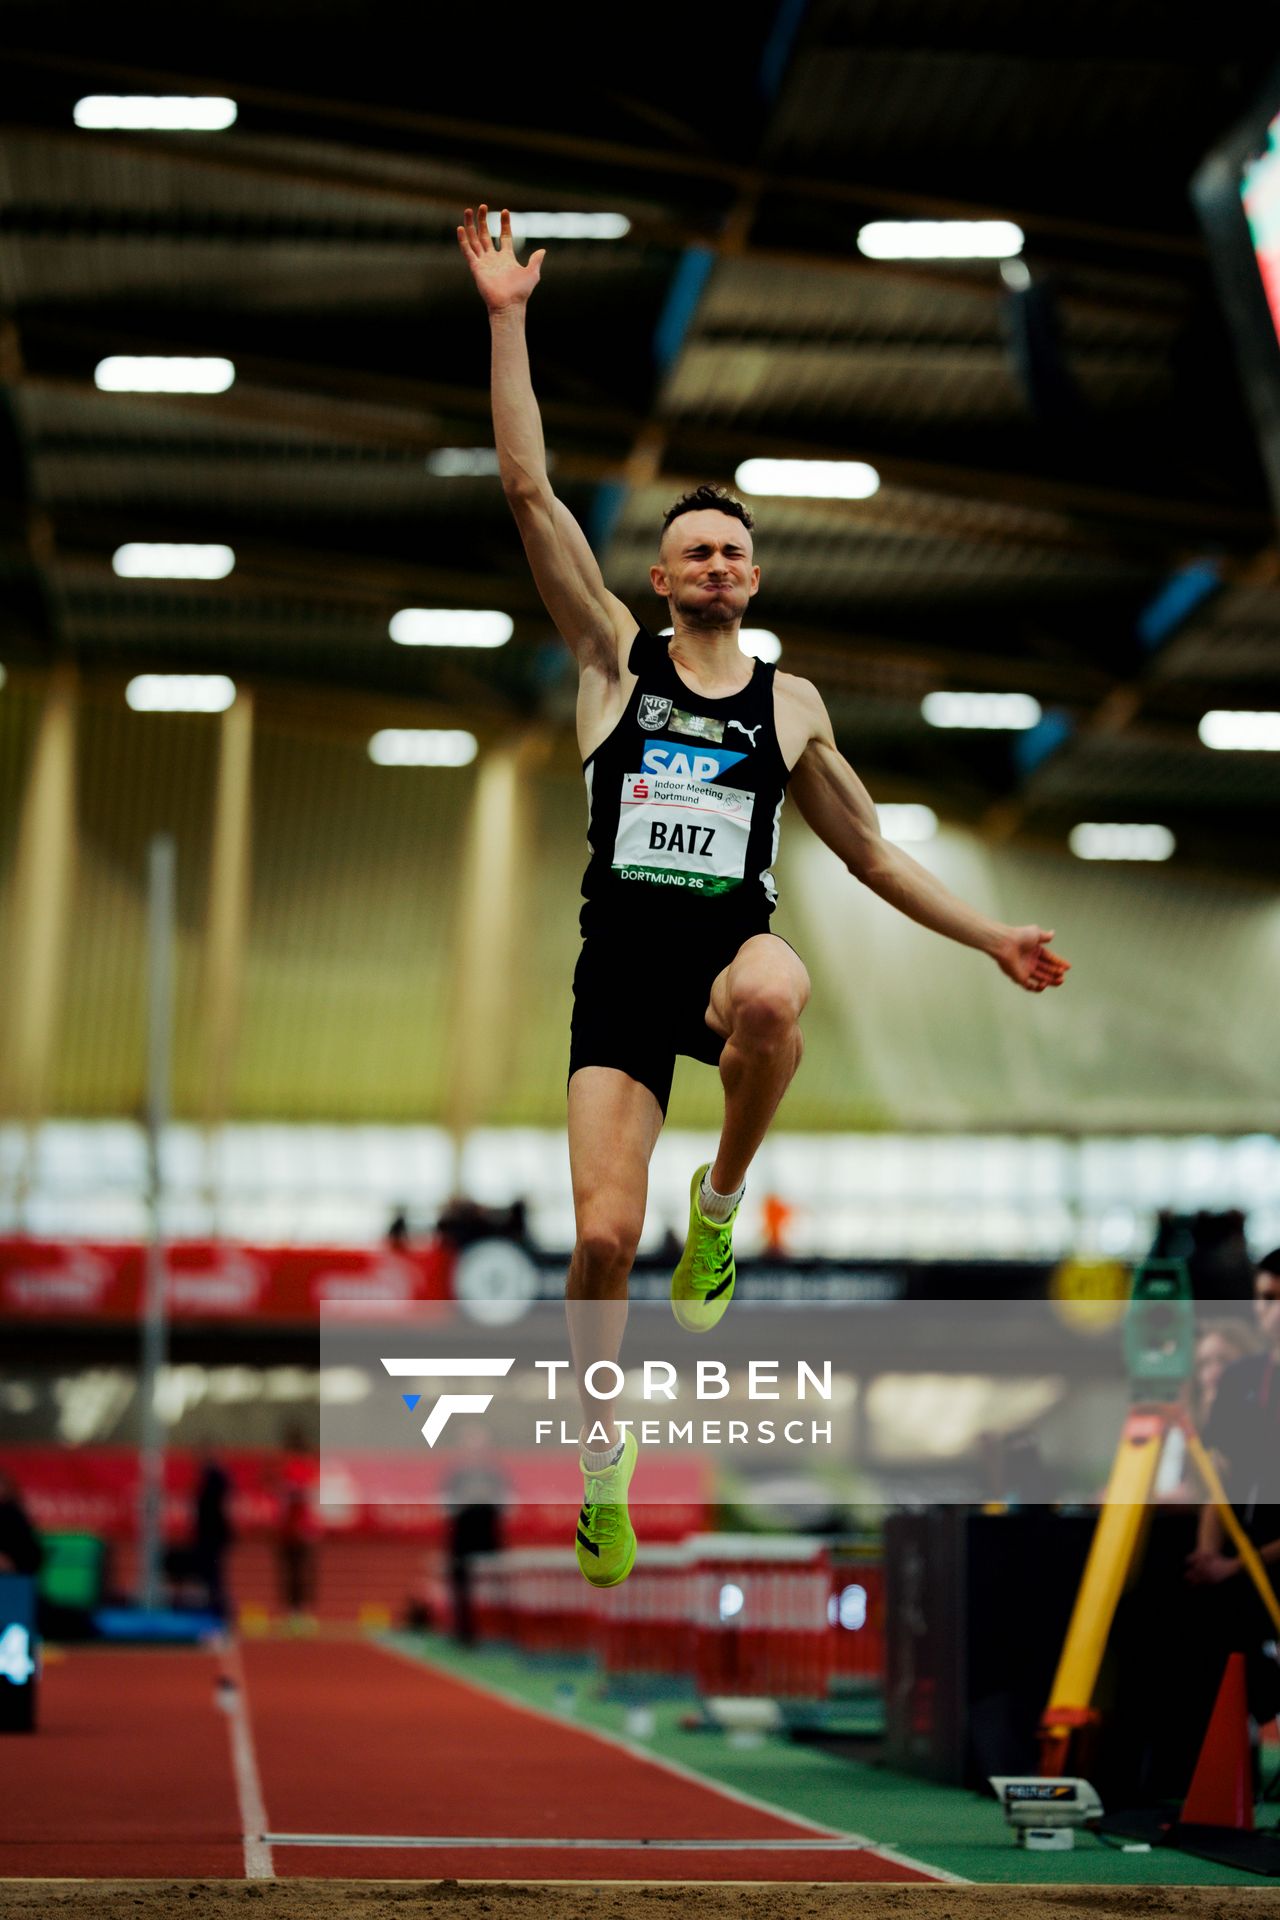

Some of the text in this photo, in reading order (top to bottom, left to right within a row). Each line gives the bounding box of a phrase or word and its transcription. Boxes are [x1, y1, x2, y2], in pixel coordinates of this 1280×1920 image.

[644, 697, 668, 709] MTG
[643, 749, 720, 781] SAP
[654, 791, 699, 804] Dortmund
[655, 780, 723, 800] Indoor Meeting
[649, 821, 716, 857] BATZ
[621, 870, 704, 888] DORTMUND 26
